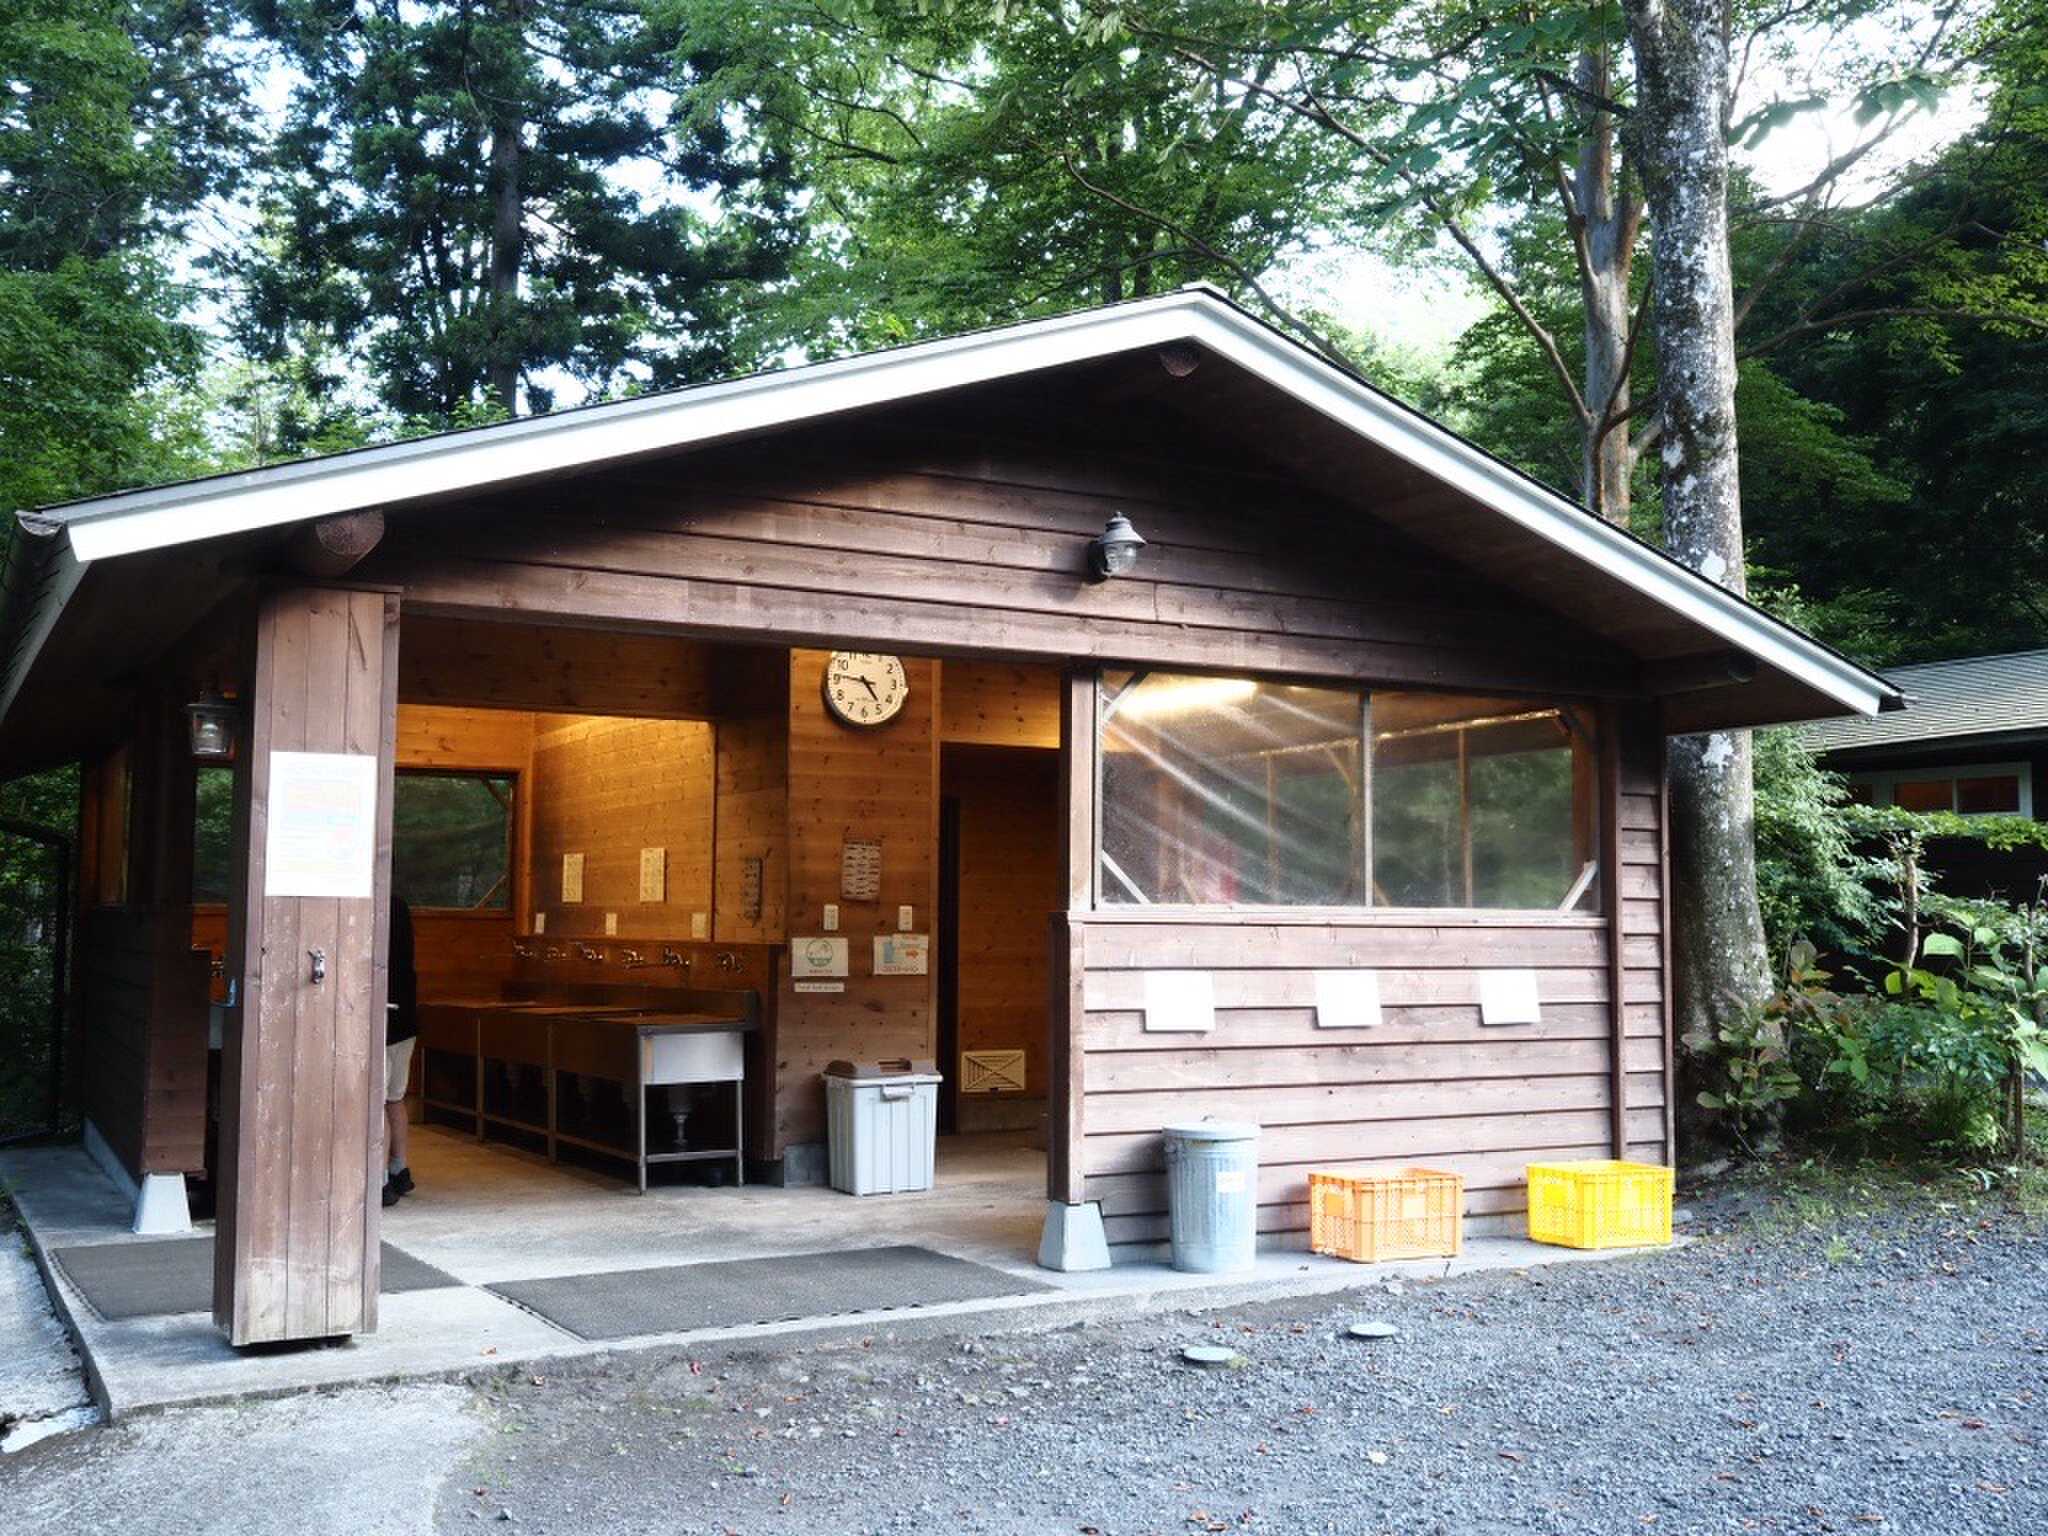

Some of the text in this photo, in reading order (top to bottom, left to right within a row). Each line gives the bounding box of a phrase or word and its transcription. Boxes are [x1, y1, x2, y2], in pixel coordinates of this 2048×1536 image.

[837, 659, 849, 671] 10
[886, 663, 893, 674] 2
[833, 673, 841, 685] 9
[891, 679, 897, 690] 3
[837, 689, 844, 701] 8
[885, 694, 893, 704] 4
[847, 702, 854, 712] 7
[862, 705, 868, 718] 6
[876, 703, 882, 715] 5
